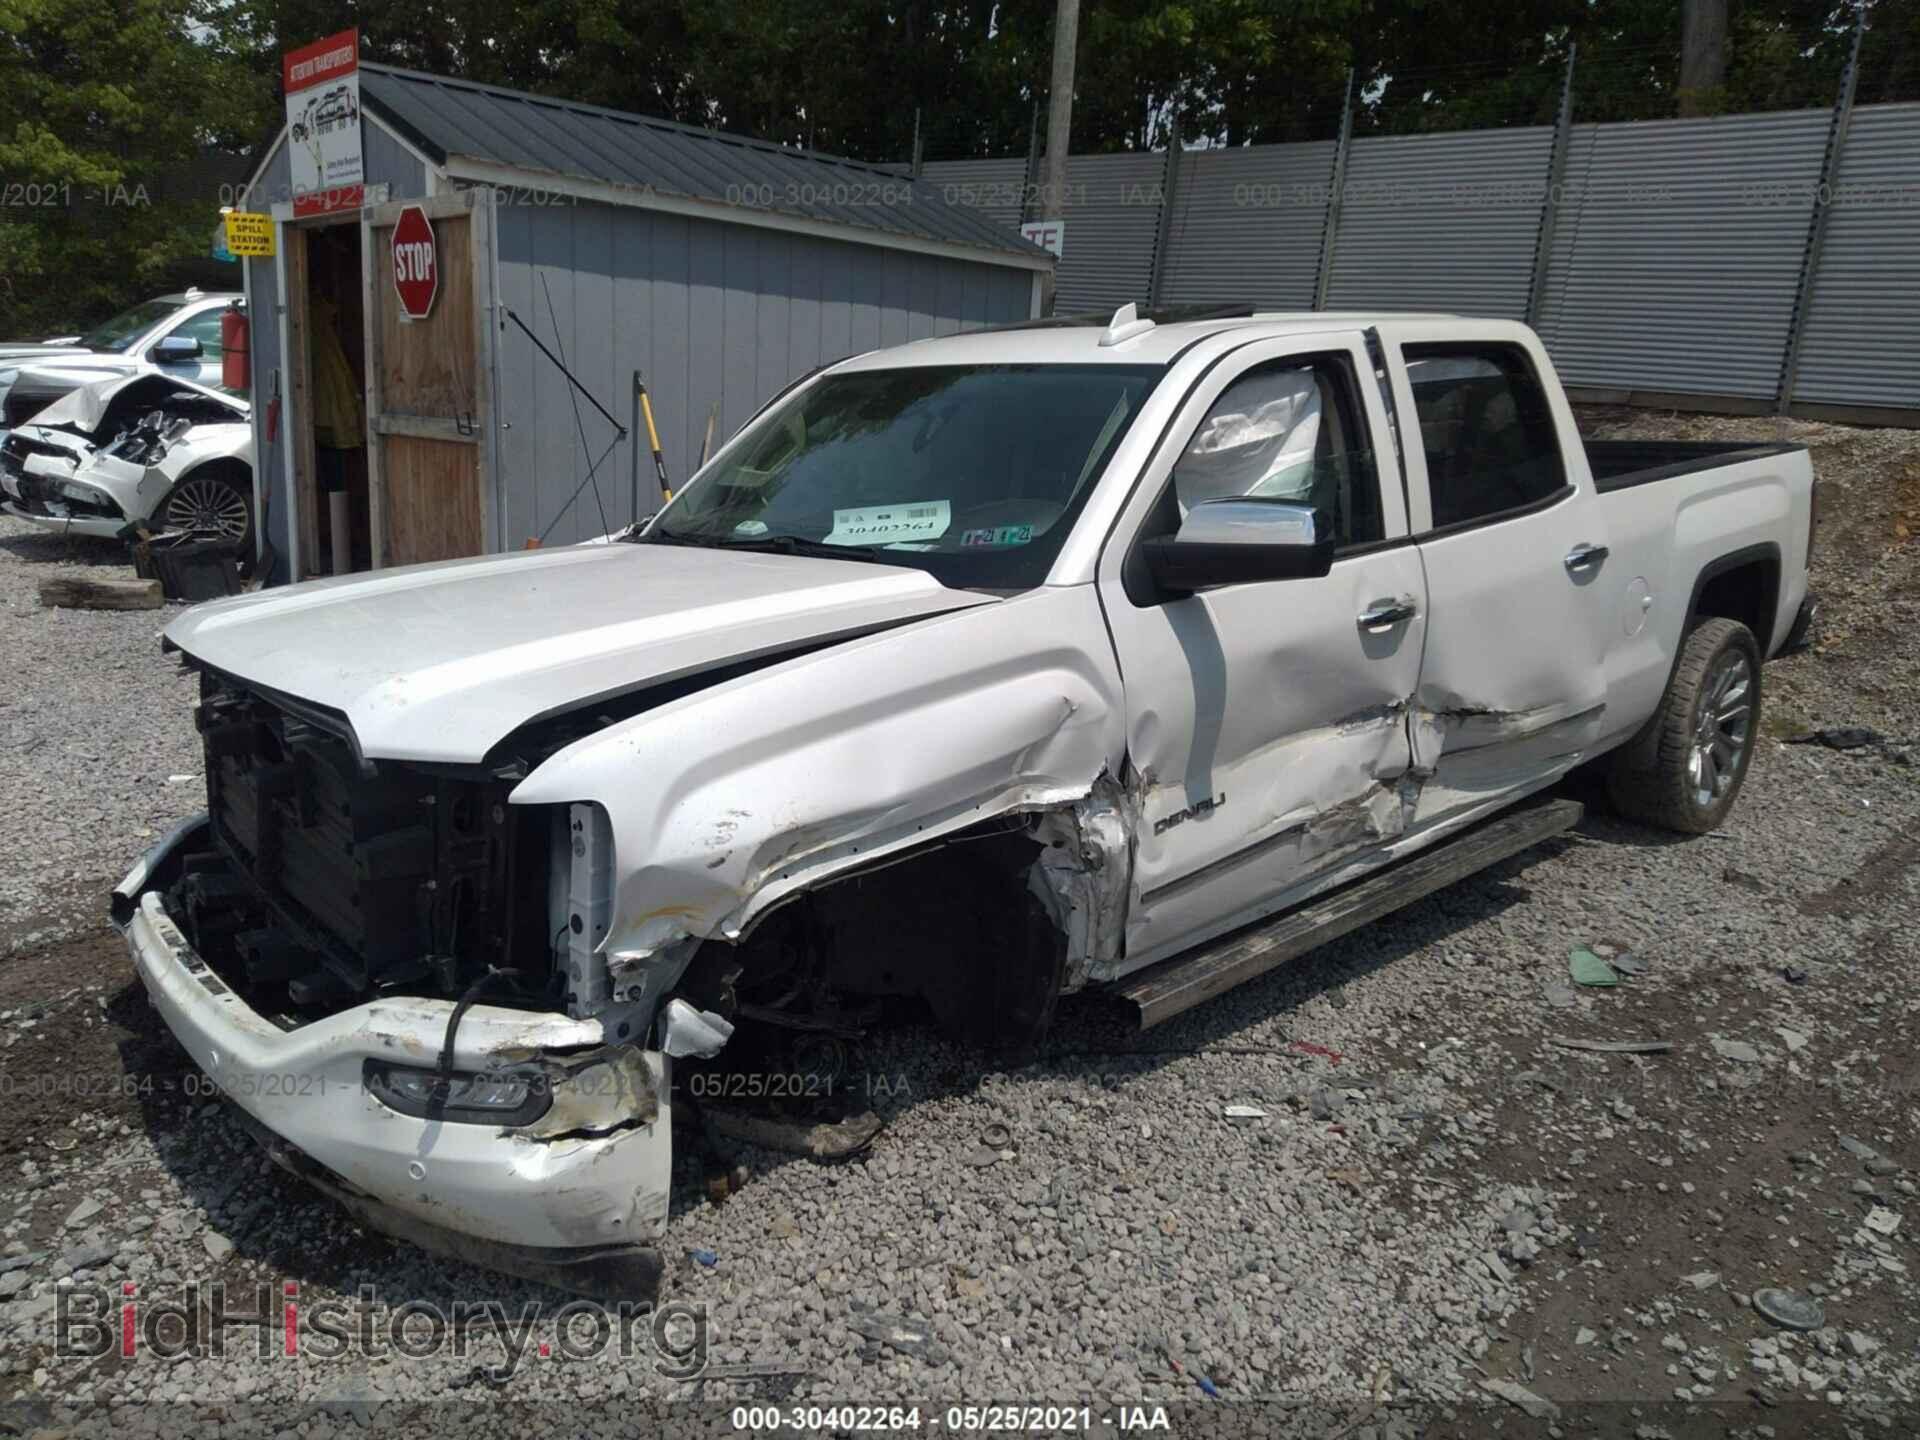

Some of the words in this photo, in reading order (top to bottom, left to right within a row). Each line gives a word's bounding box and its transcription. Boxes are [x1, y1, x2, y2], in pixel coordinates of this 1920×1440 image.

[230, 235, 270, 244] STATION
[236, 224, 262, 233] SPILL
[396, 241, 432, 281] STOP
[1153, 792, 1226, 837] DENALI
